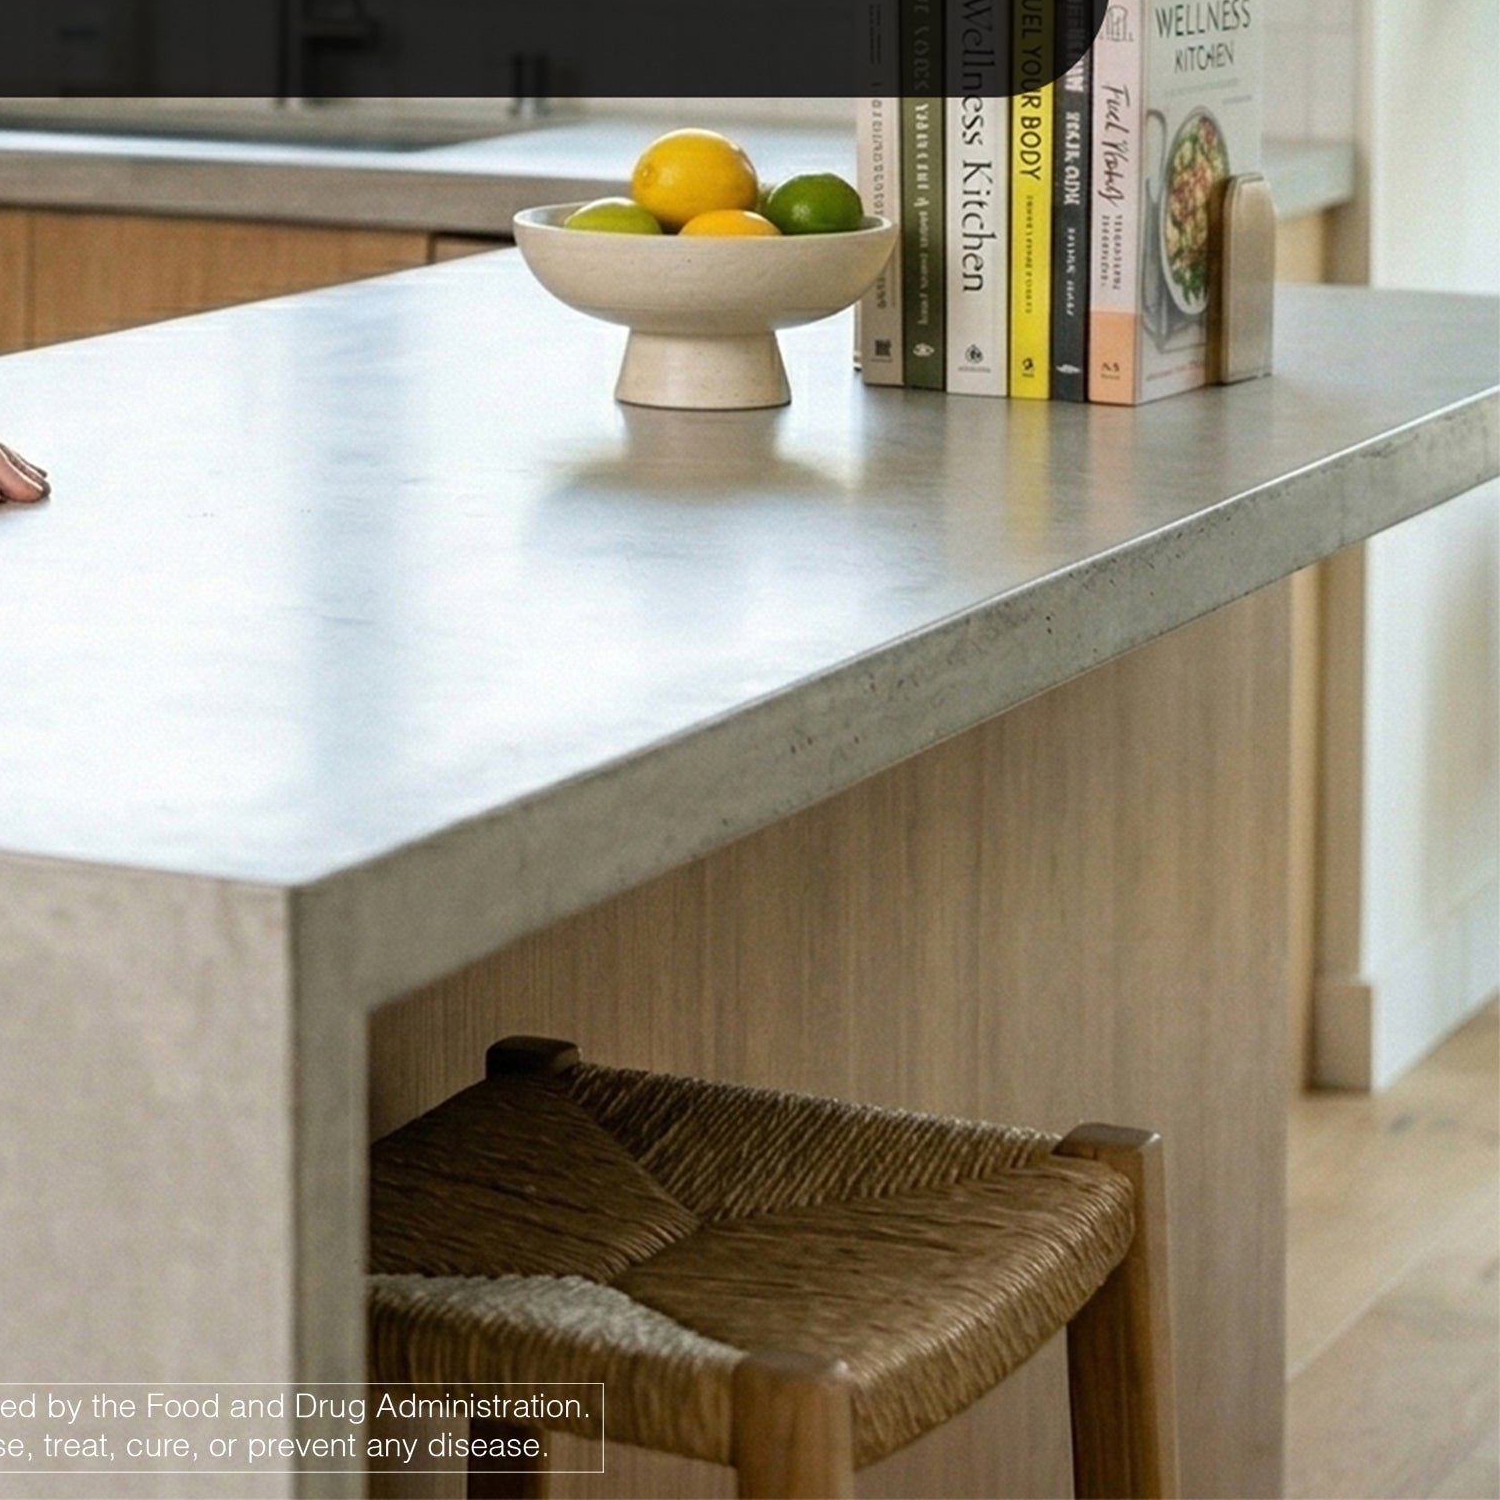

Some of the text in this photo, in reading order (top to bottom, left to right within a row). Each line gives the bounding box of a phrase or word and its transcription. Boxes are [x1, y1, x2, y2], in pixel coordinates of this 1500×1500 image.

[1021, 46, 1042, 109] YOUR
[1174, 41, 1235, 73] KITCHEN
[1101, 84, 1130, 134] Fuel
[1020, 115, 1042, 181] BODY
[962, 160, 997, 292] Kitchen
